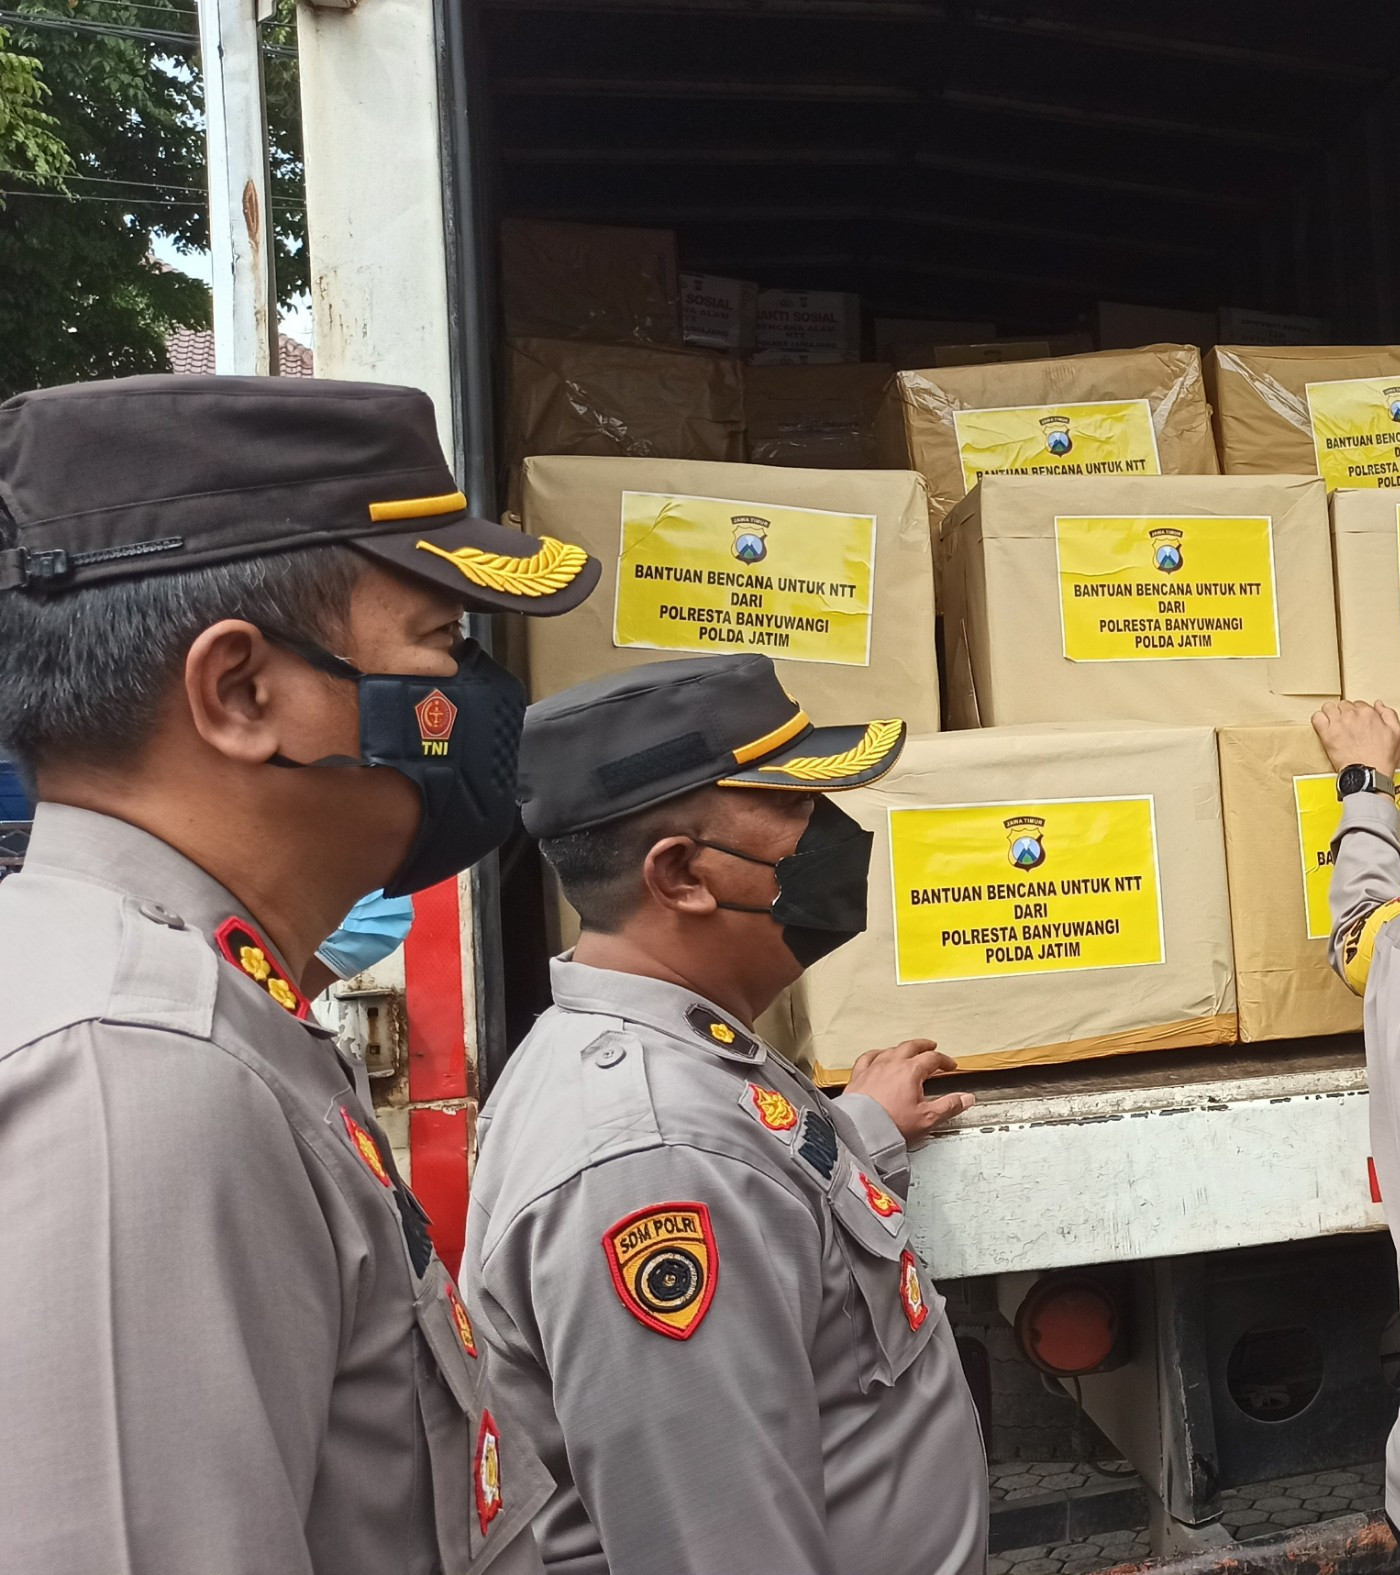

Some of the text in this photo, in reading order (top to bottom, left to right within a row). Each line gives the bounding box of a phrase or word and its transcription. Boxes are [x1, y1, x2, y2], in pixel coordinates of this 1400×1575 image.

[687, 293, 733, 310] SOSIAL
[793, 312, 840, 323] SOSIAL
[1326, 434, 1373, 449] BANTUAN
[1086, 461, 1122, 475] UNTUK
[1125, 459, 1146, 472] NTT
[1348, 462, 1398, 476] POLRESTA
[634, 564, 856, 598] BANTUAN BENCANA UNTUK NTT
[1074, 583, 1261, 597] BANTUAN BENCANA UNTUK NTT
[730, 592, 762, 608] DARI
[1158, 601, 1185, 613] DARI
[659, 605, 829, 633] POLRESTA BANYUWANGI
[1099, 618, 1243, 632] POLRESTA BANYUWANGI
[699, 627, 789, 647] POLDA JATIM
[1135, 634, 1212, 648] POLDA JATIM
[422, 741, 448, 756] TNI
[1023, 818, 1043, 826] TIMUR
[911, 876, 1142, 905] BANTUAN BENCANA UNTUK NTT
[1014, 903, 1047, 920] DARI
[942, 918, 1119, 946] POLRESTA BANYUWANGI
[986, 942, 1080, 963] POLDA JATIM
[620, 1218, 697, 1254] SDM POLRI
